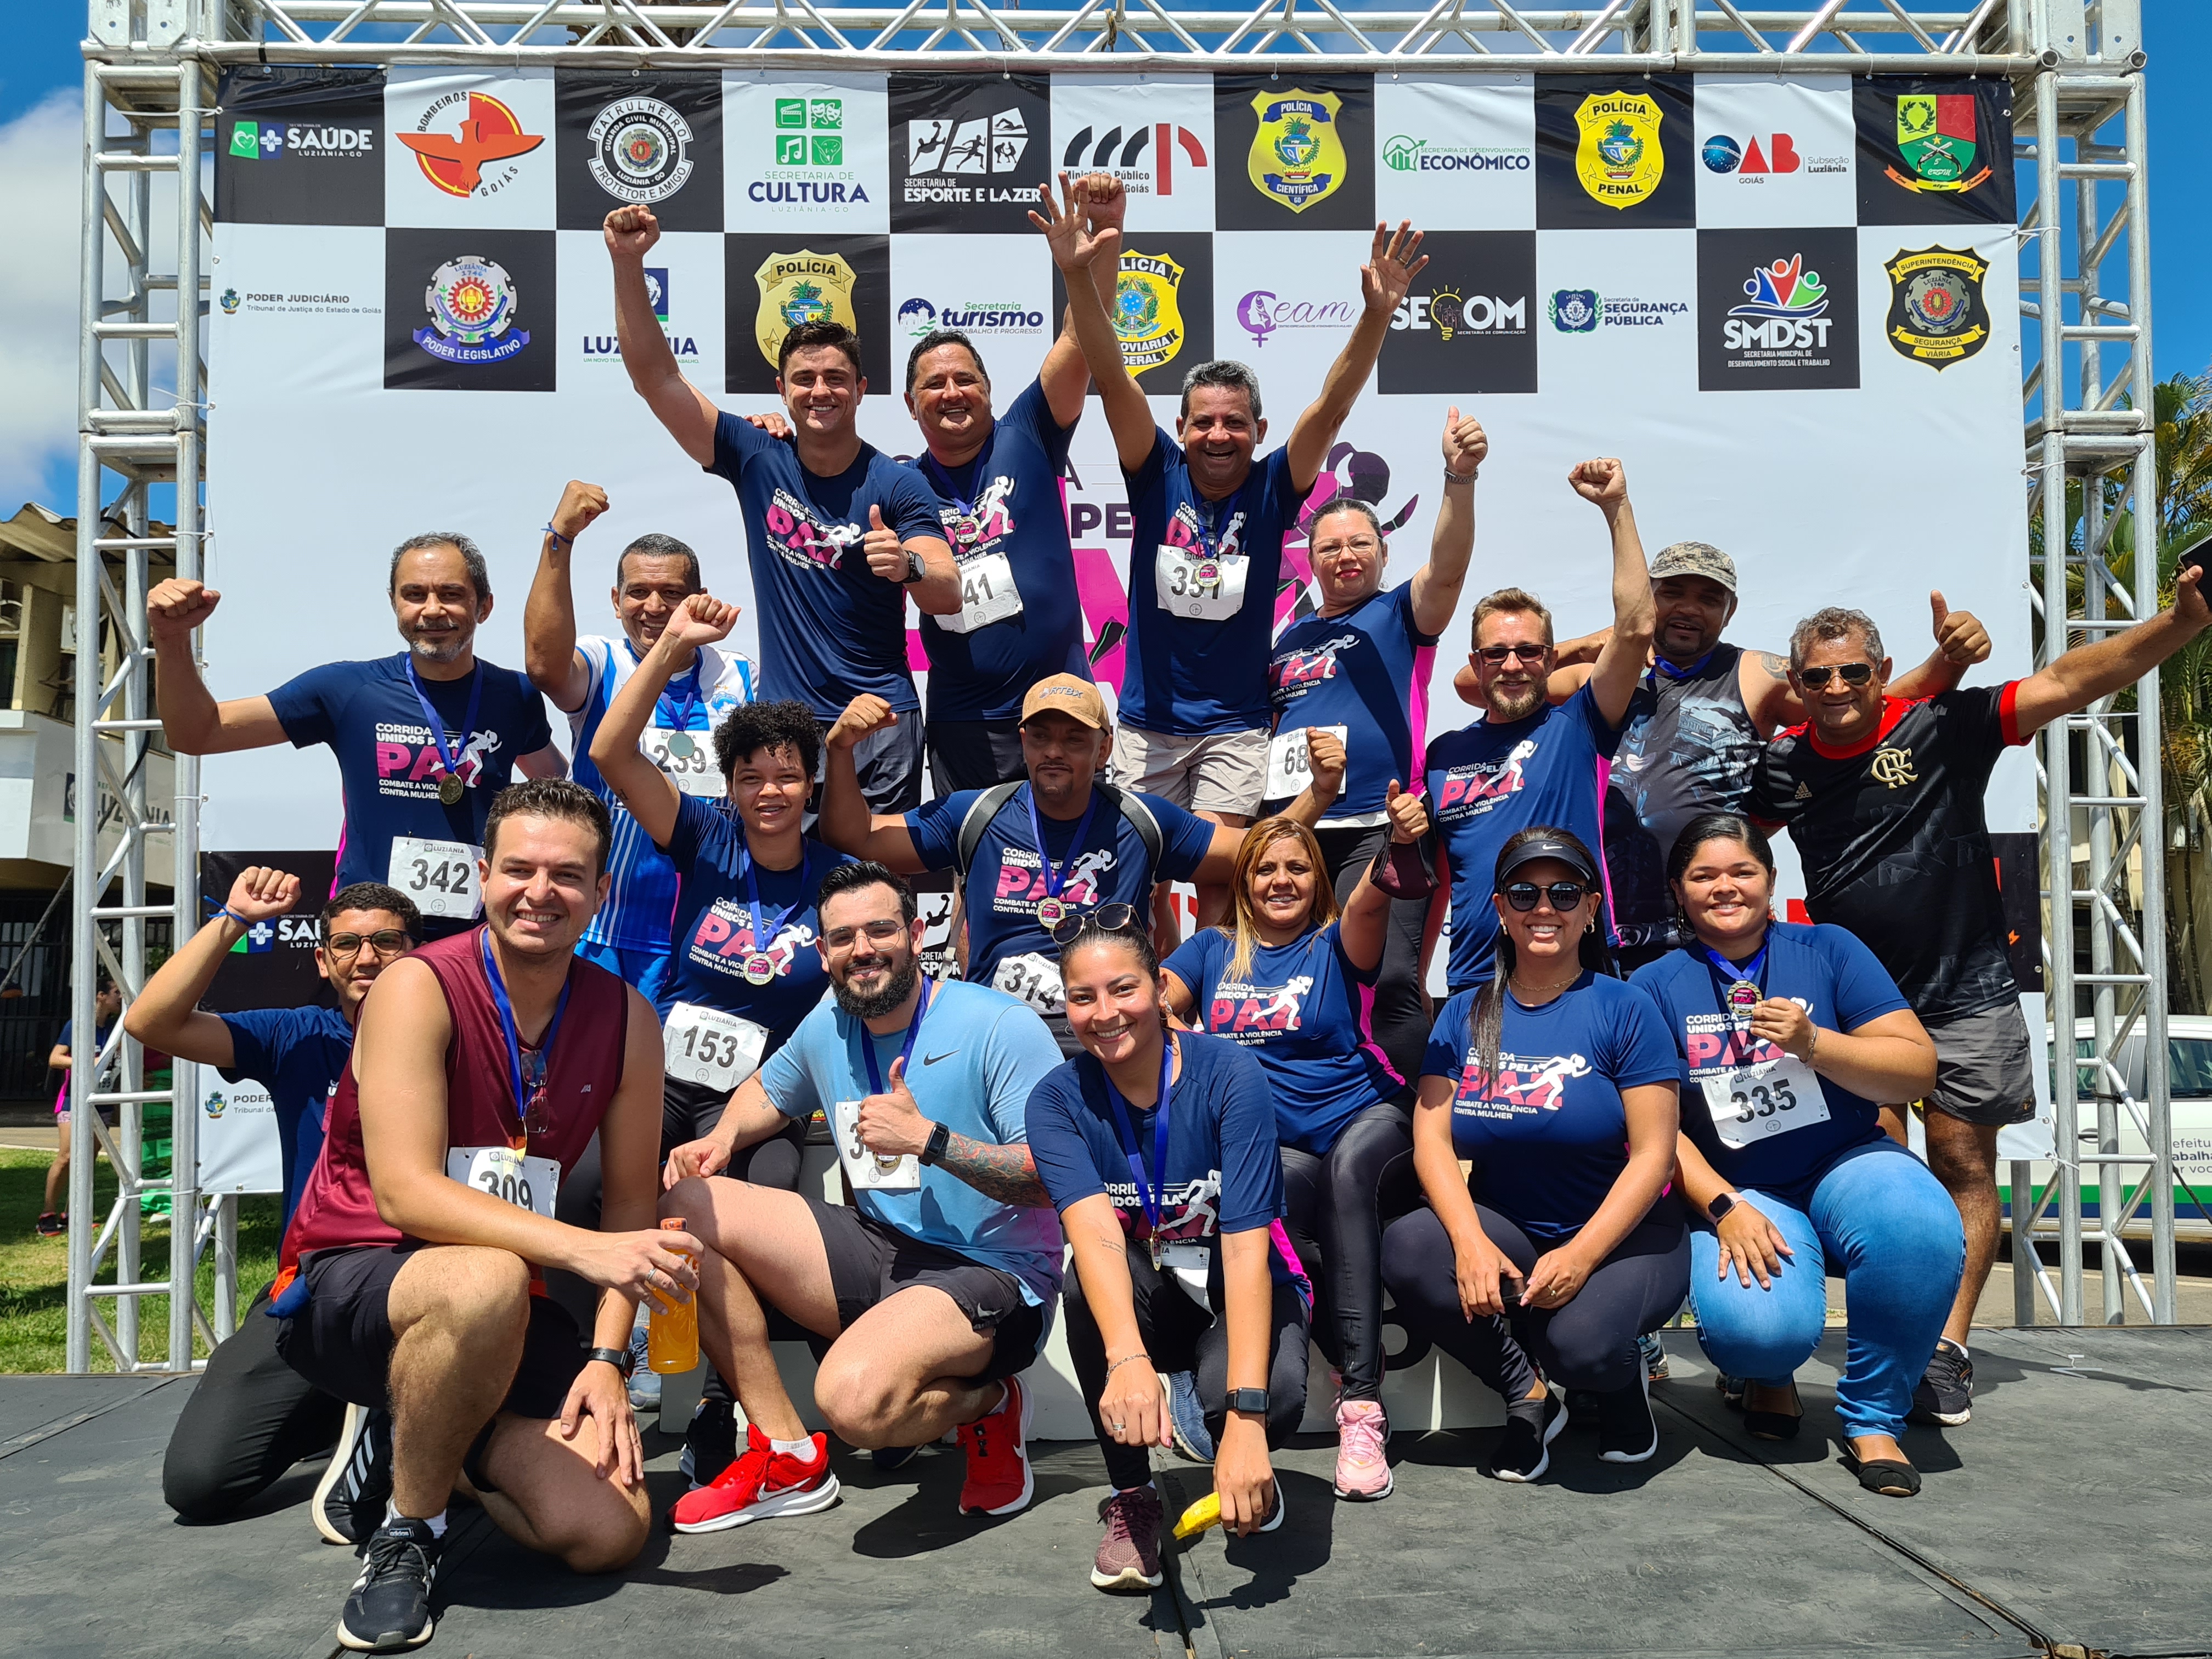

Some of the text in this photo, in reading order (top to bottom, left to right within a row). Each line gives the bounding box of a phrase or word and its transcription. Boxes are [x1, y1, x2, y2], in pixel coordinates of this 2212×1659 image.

[417, 91, 467, 132] BOMBEIROS
[1280, 100, 1313, 114] POLÍCIA
[1593, 100, 1646, 116] POLÍCIA
[594, 100, 686, 138] PATRULHEIRO
[287, 127, 373, 150] SAÚDE
[605, 115, 676, 155] GUARDA CIVIL MUNICIPAL
[1421, 153, 1530, 171] ECONÔMICO
[1808, 156, 1849, 165] Subseção
[764, 171, 854, 180] SECRETARIA DE
[1114, 171, 1150, 180] Público
[1808, 165, 1847, 173] Luziânia
[481, 166, 518, 197] GOIÁS
[595, 165, 686, 199] PROTETOR E AMIGO
[654, 171, 665, 181] GO
[1739, 175, 1765, 184] GOIÁS
[904, 178, 956, 188] SECRETARIA DE
[1125, 183, 1149, 193] Goiás
[1276, 183, 1319, 194] CIENTÍFICA
[1598, 183, 1644, 195] PENAL
[748, 181, 870, 204] CULTURA
[904, 188, 1041, 202] ESPORTE E LAZER
[454, 263, 487, 273] LUZIÂNIA
[776, 259, 837, 276] POLÍCIA
[1120, 258, 1166, 276] LÍCIA
[1900, 258, 1974, 271] SUPERINTENDÊNCIA
[246, 292, 350, 303] PODER JUDICIÁRIO
[288, 306, 313, 314] Justiça
[964, 301, 1022, 311] Secretaria
[1604, 303, 1689, 315] SEGURANÇA
[941, 308, 1043, 327] turismo
[1604, 314, 1664, 326] PÚBLICA
[1723, 318, 1833, 349] SMDST
[422, 335, 521, 360] PODER LEGISLATIVO
[1120, 336, 1171, 352] OVIÁRIA
[1914, 336, 1962, 347] SEGURANÇA
[1926, 348, 1952, 358] VIÁRIA
[772, 495, 806, 521] UNIDOS
[775, 488, 809, 516] CORRIDA
[969, 537, 1002, 555] VIOLÊNCIA
[785, 554, 810, 570] MULHER
[962, 551, 988, 567] MULHER
[1290, 679, 1321, 691] VIOLÊNCIA
[1285, 689, 1307, 698] MULHER
[375, 723, 432, 736] CORRIDA
[376, 732, 425, 745] UNIDOS
[1448, 762, 1486, 774] CORRIDA
[379, 778, 414, 789] COMBATE
[379, 787, 440, 799] CONTRA MULHER
[1437, 805, 1467, 816] COMBATE
[1474, 794, 1509, 808] VIOLÊNCIA
[1440, 805, 1493, 823] CONTRA MULHER
[1002, 856, 1042, 868] UNIDOS
[409, 858, 470, 895] 342
[994, 898, 1030, 907] COMBATE
[710, 904, 745, 927] UNIDOS
[993, 905, 1024, 914] CONTRA
[691, 945, 720, 964] COMBATE
[689, 952, 713, 970] CONTRA
[714, 962, 744, 979] MULHER
[1004, 963, 1062, 1010] 314
[1215, 990, 1248, 1000] UNIDOS
[1686, 1012, 1739, 1024] CORRIDA
[1246, 1030, 1283, 1039] VIOLÊNCIA
[1686, 1022, 1733, 1034] UNIDOS
[682, 1024, 738, 1068] 153
[1508, 1062, 1539, 1073] PELA
[1689, 1066, 1727, 1076] COMBATE
[1455, 1099, 1482, 1109] COMBATE
[1491, 1103, 1538, 1114] VIOLÊNCIA
[1730, 1078, 1797, 1123] 335
[1454, 1108, 1513, 1120] CONTRA MULHER
[478, 1170, 533, 1212] 309
